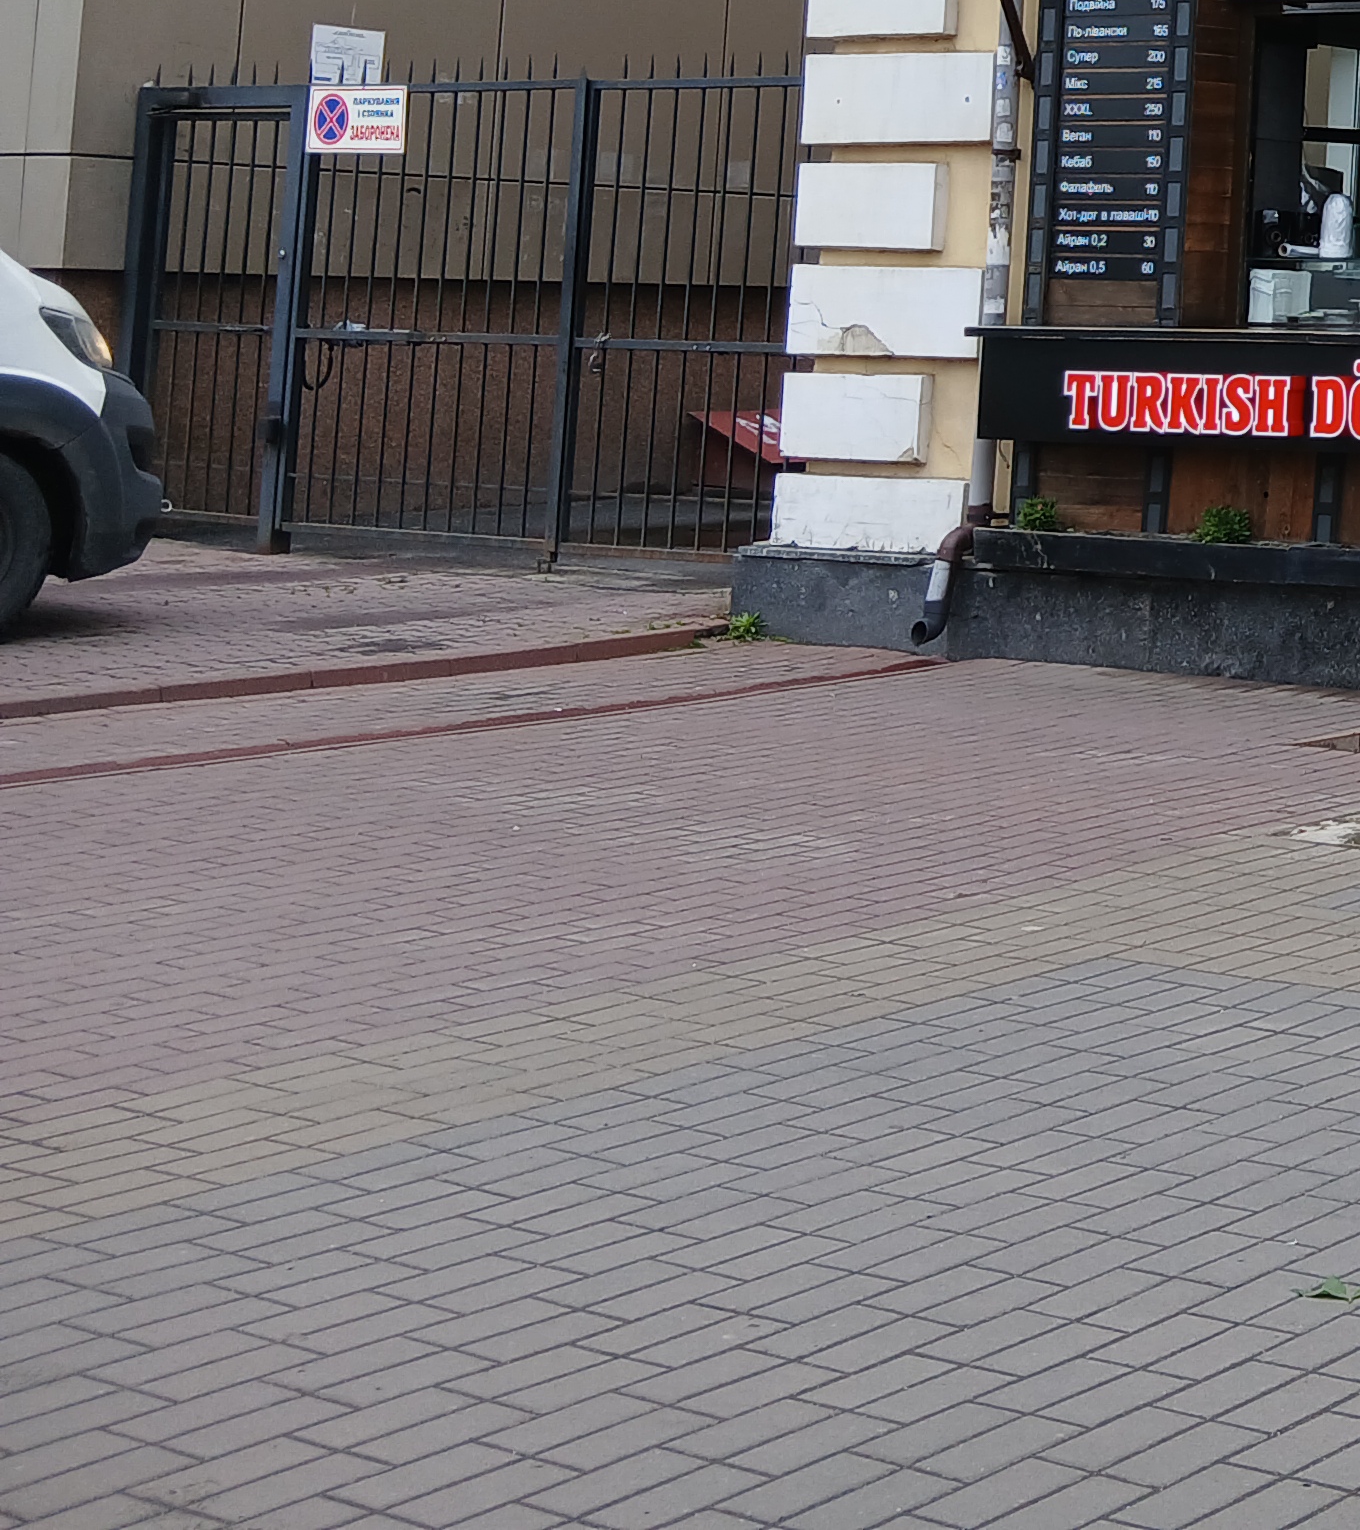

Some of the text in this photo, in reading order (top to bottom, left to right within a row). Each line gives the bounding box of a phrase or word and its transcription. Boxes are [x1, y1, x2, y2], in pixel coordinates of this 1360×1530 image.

[1067, 50, 1165, 64] Супер 200
[1146, 76, 1163, 89] 215
[1144, 103, 1163, 116] 250
[350, 125, 400, 141] ЗАБОРОНЕНА
[1062, 129, 1092, 142] Веган
[1061, 155, 1161, 168] Кебаб 150
[1060, 180, 1114, 195] Фалафель
[1056, 233, 1089, 247] Айран
[1143, 236, 1155, 248] 30
[1055, 260, 1087, 275] Айран
[1141, 262, 1154, 274] 60
[1063, 369, 1291, 437] TURKISH
